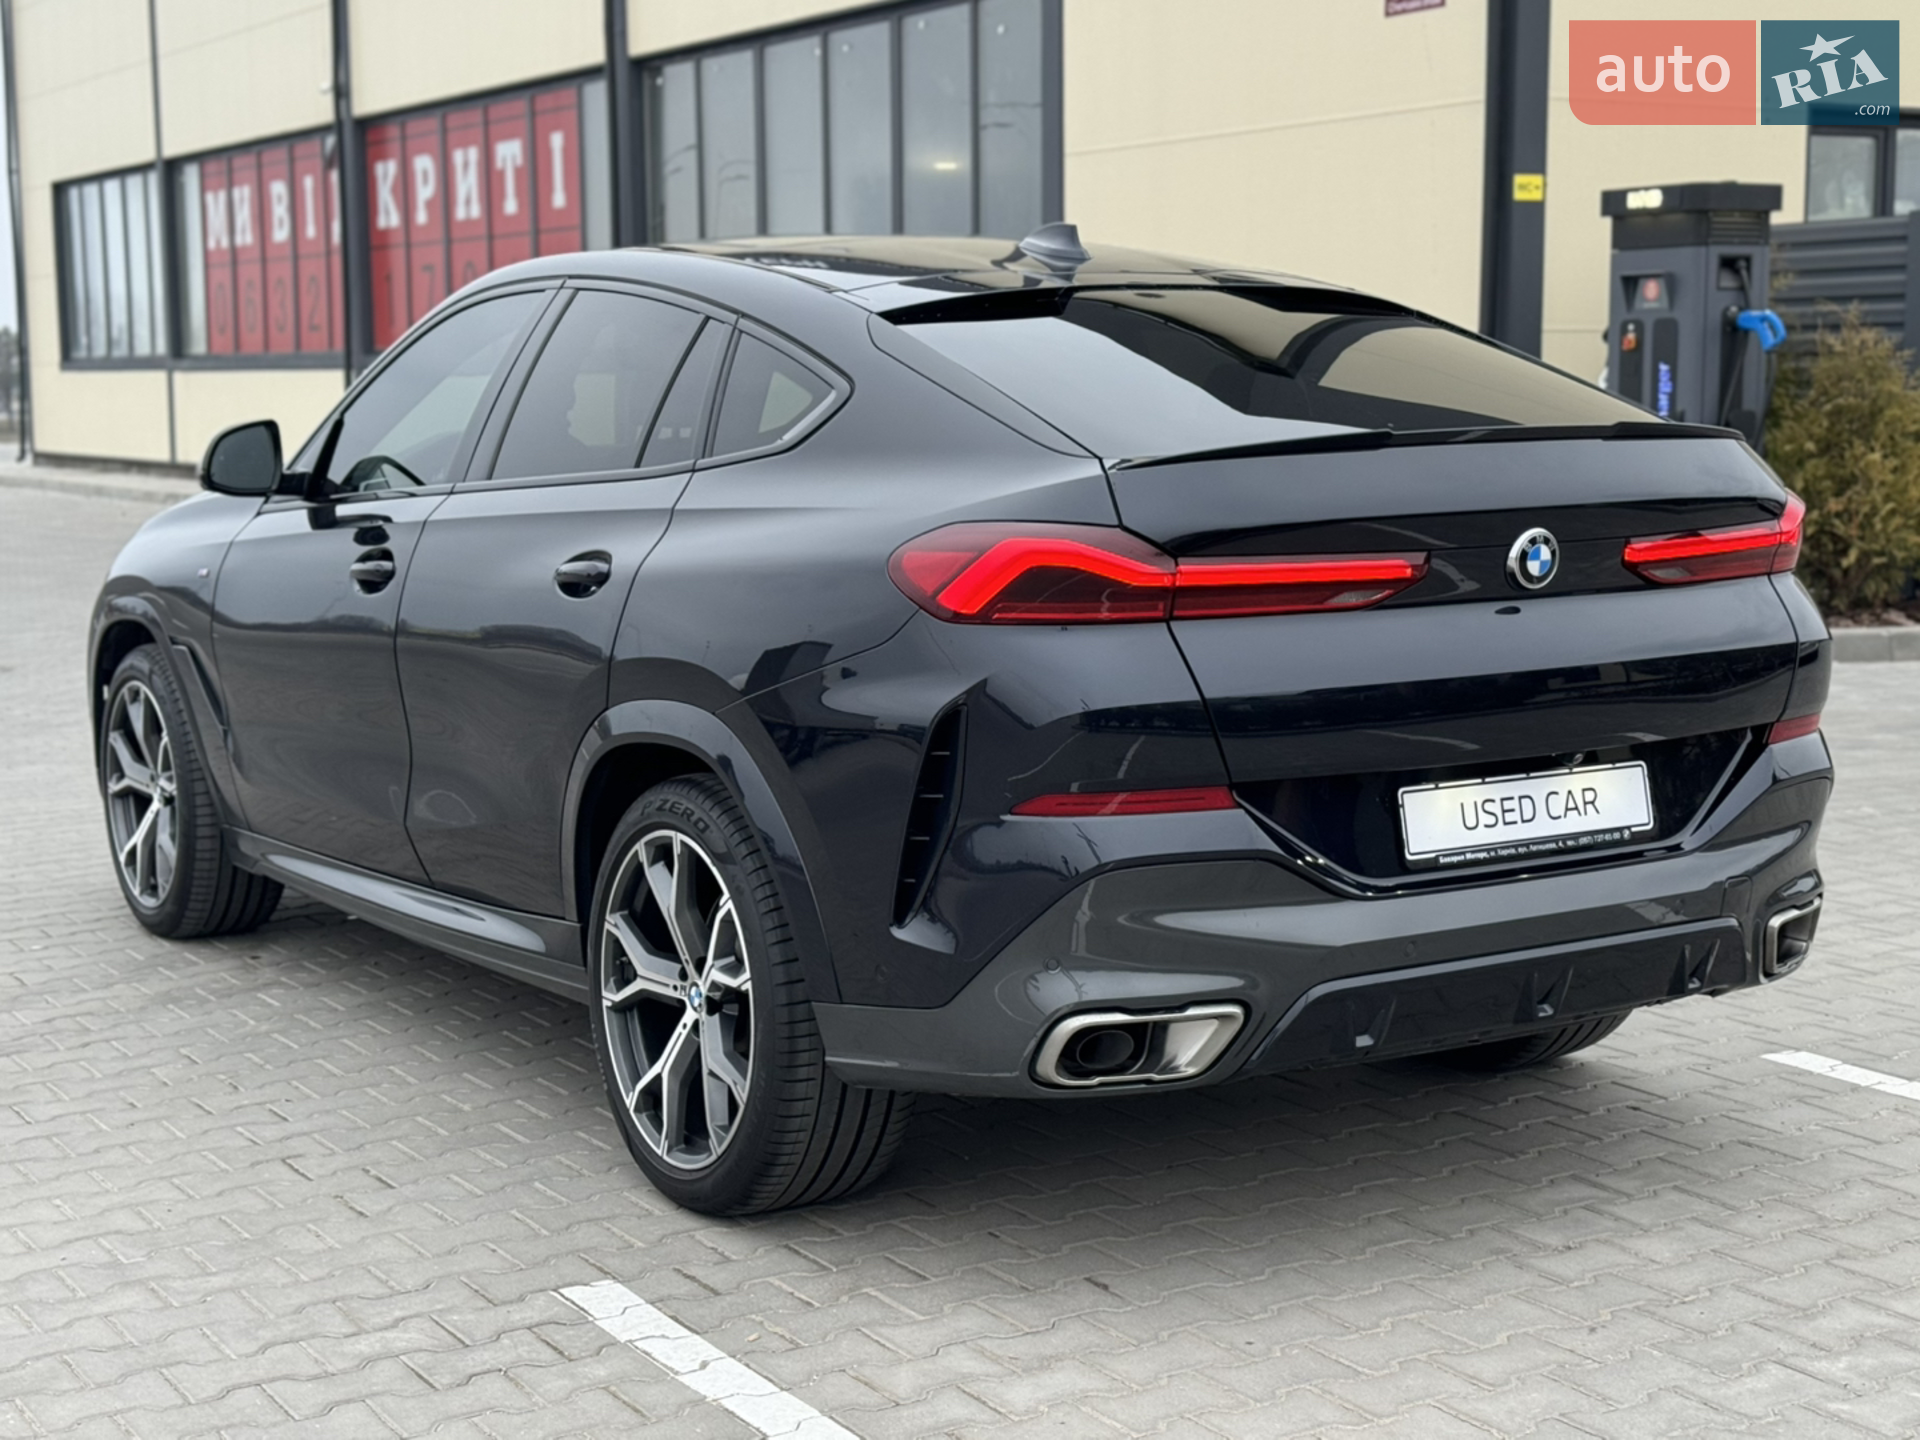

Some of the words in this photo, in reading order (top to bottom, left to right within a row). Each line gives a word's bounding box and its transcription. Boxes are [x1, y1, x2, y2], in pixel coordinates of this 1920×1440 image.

[655, 799, 711, 834] ZERO
[1460, 794, 1537, 831] USED
[1545, 787, 1601, 821] CAR
